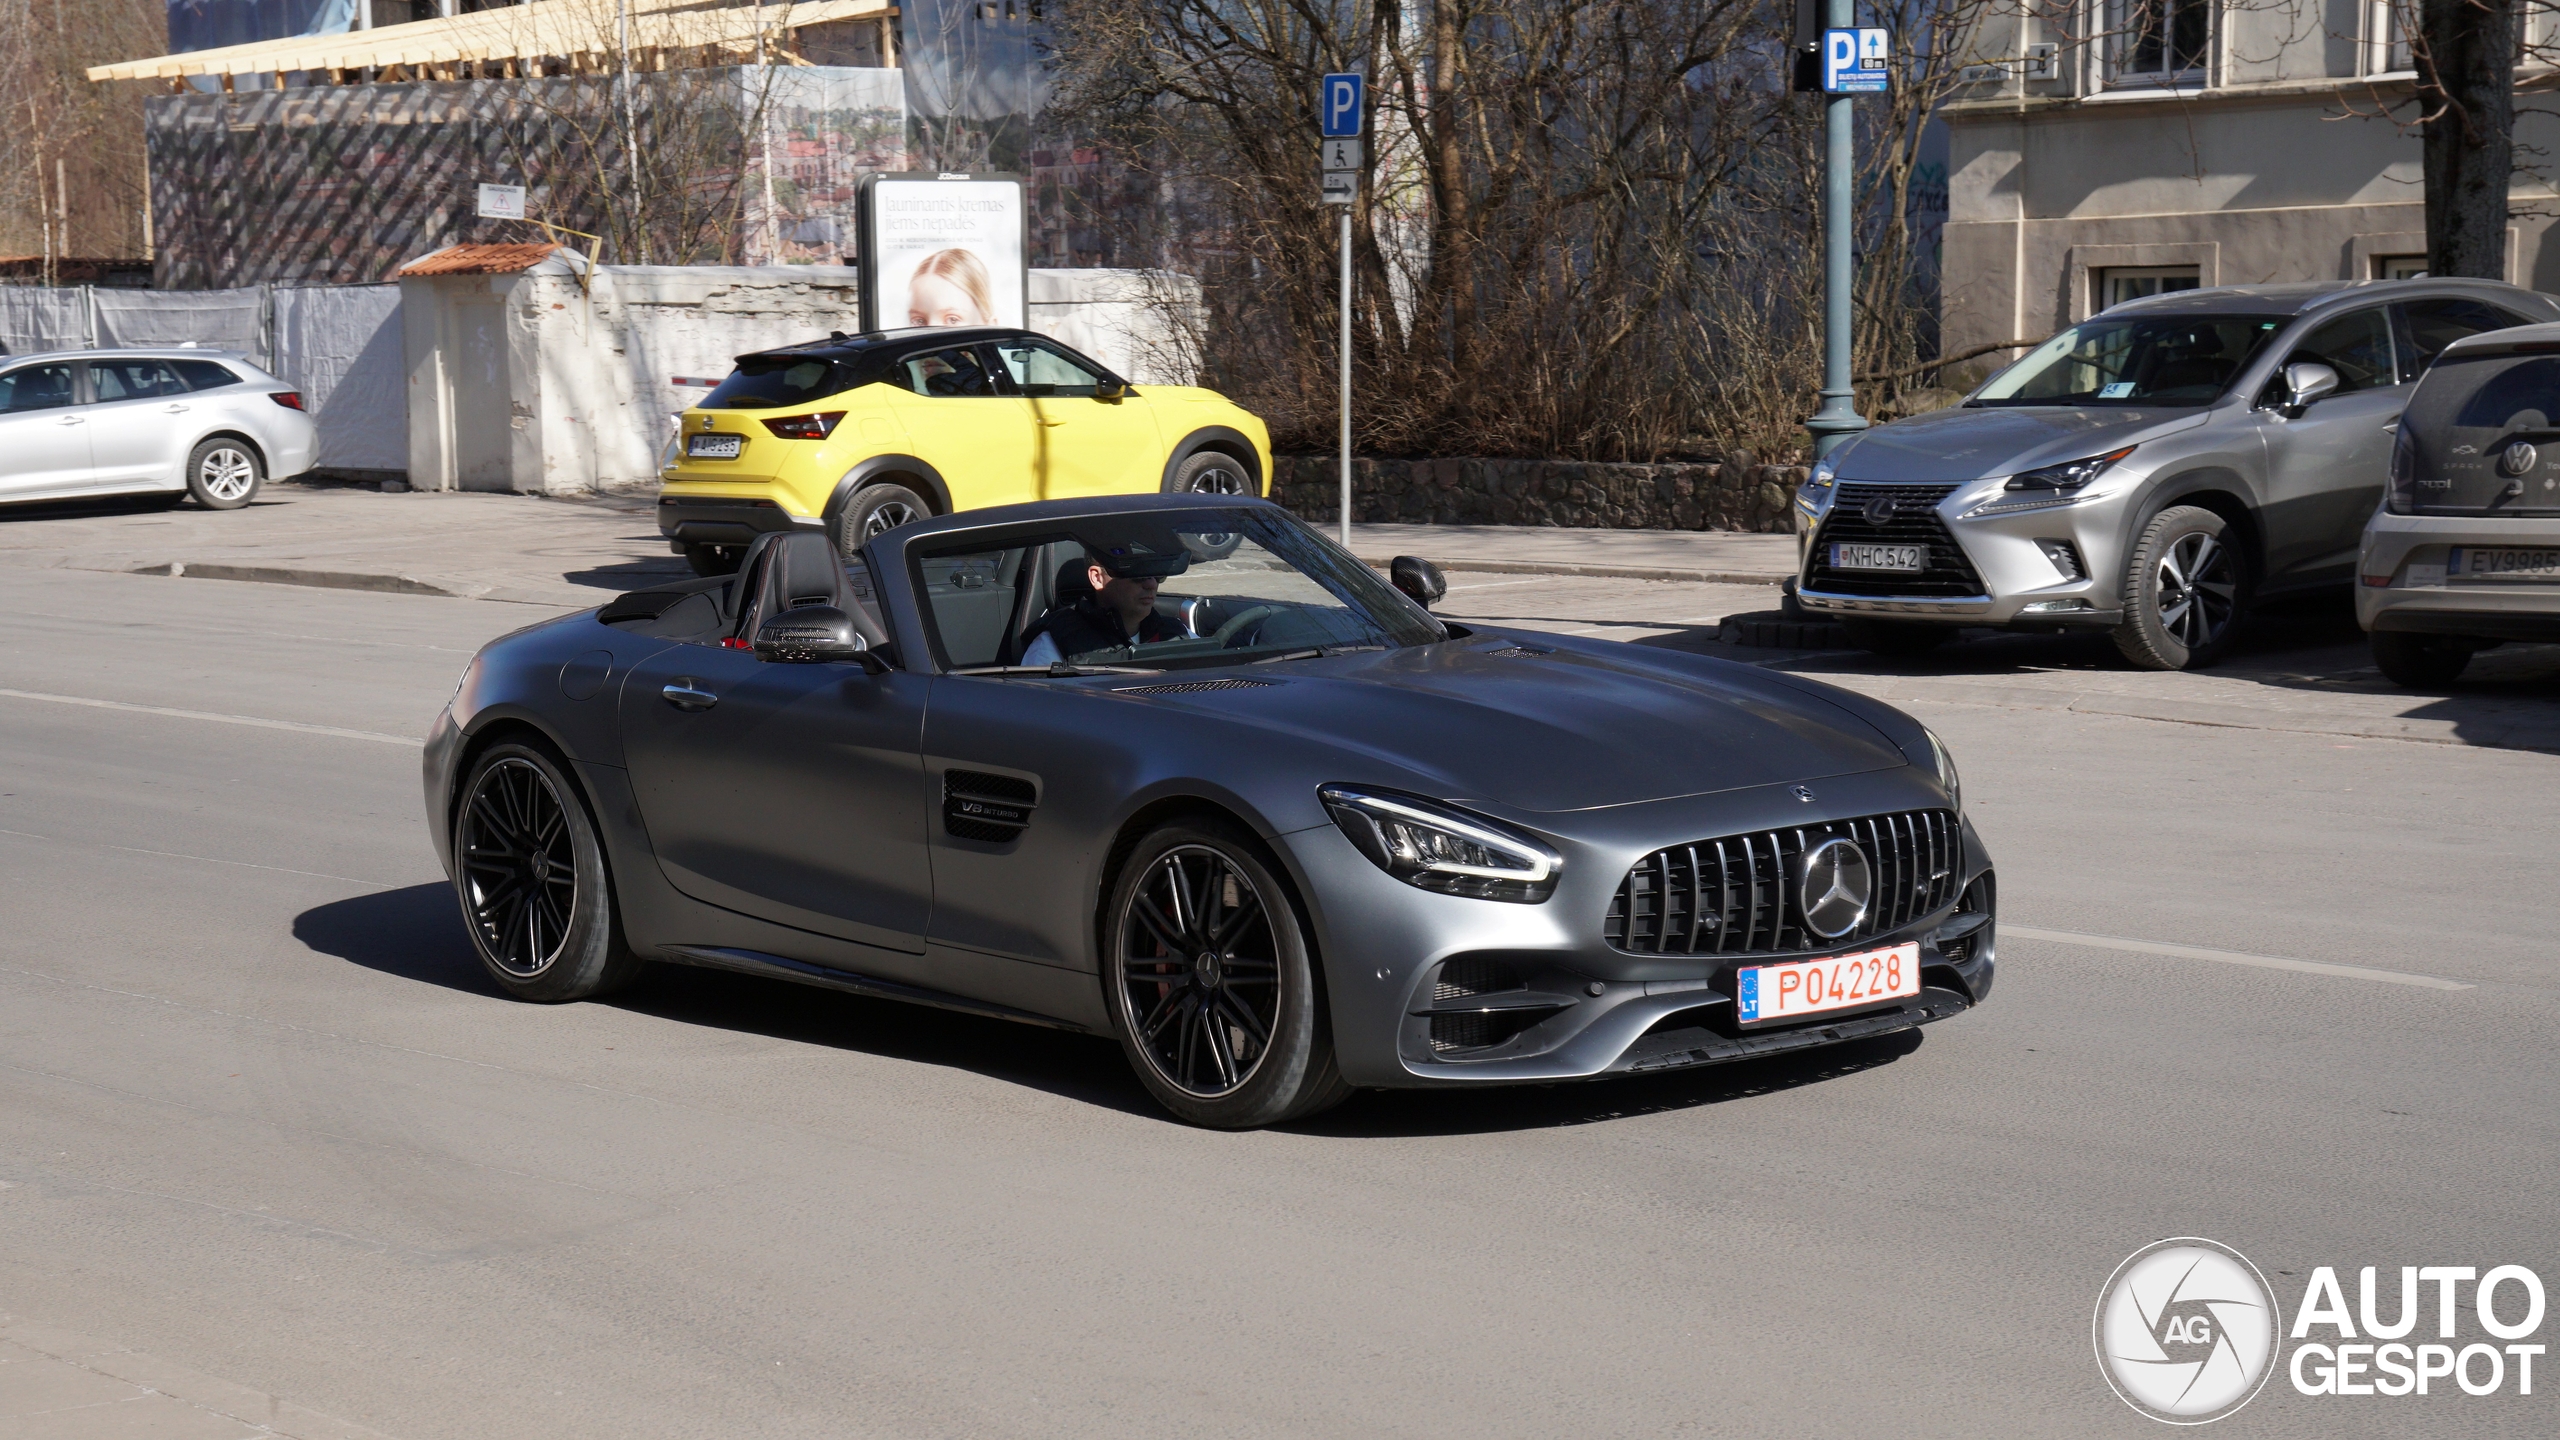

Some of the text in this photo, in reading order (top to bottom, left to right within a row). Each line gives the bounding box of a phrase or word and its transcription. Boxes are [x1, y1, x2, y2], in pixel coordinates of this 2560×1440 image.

[1828, 32, 1856, 89] P
[1863, 58, 1883, 69] 60 m
[1332, 81, 1355, 129] P
[1328, 176, 1333, 186] 5
[884, 196, 1005, 213] Jauninantis kremas
[884, 214, 976, 234] jiems nepadės
[961, 801, 1019, 819] V8 BITURBO
[1779, 953, 1901, 1010] P04228
[1742, 1000, 1758, 1013] LT
